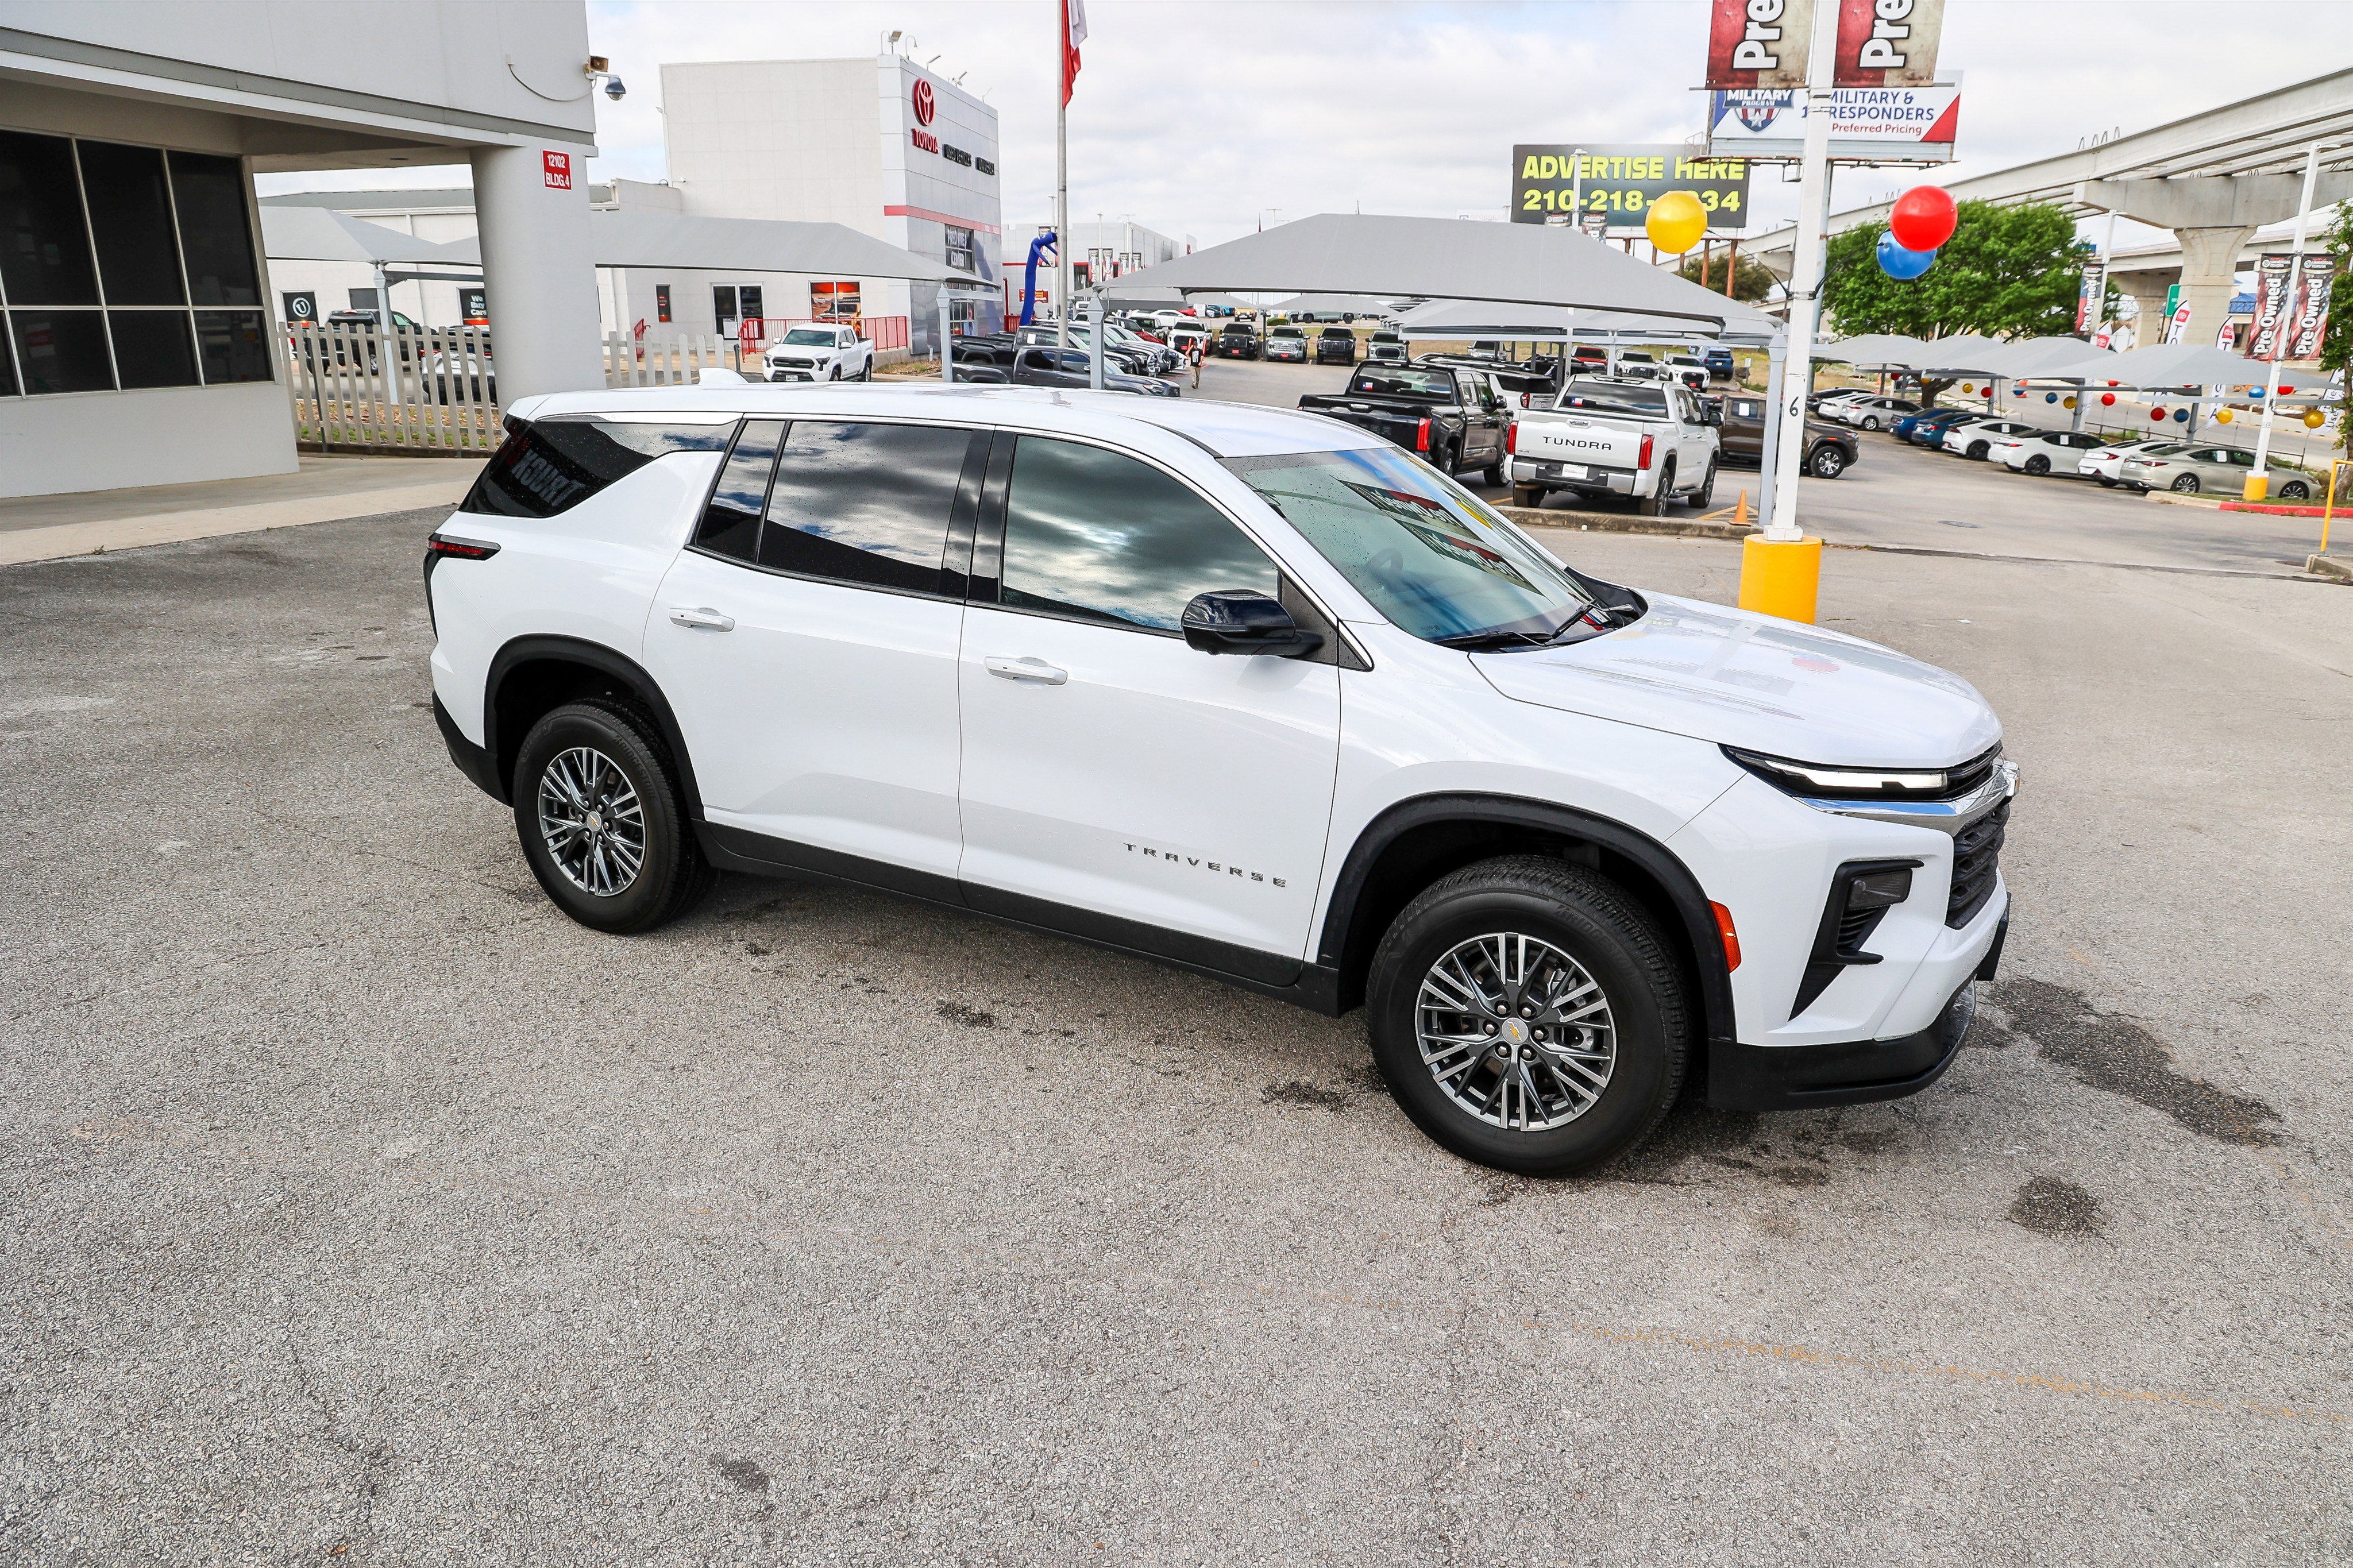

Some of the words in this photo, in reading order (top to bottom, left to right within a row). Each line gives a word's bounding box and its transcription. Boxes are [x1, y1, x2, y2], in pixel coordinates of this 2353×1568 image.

[1733, 0, 1785, 69] Pre
[1860, 0, 1915, 68] Pre
[1727, 89, 1792, 101] MILITARY
[1904, 91, 1914, 105] &
[913, 129, 939, 154] TOYOTA
[1832, 123, 1882, 133] Preferred
[1885, 123, 1923, 136] Pricing
[547, 153, 566, 168] 12102
[1522, 156, 1664, 180] ADVERTISE
[1674, 156, 1745, 180] HERE
[565, 174, 570, 187] 4
[470, 301, 485, 310] Buy
[2259, 277, 2282, 329] Owned
[2300, 279, 2323, 329] Owned
[2253, 330, 2273, 354] Pre
[2294, 331, 2315, 355] Pre
[1789, 396, 1799, 417] 6
[1542, 436, 1612, 451] TUNDRA
[1123, 840, 1287, 889] TRAVERSE
